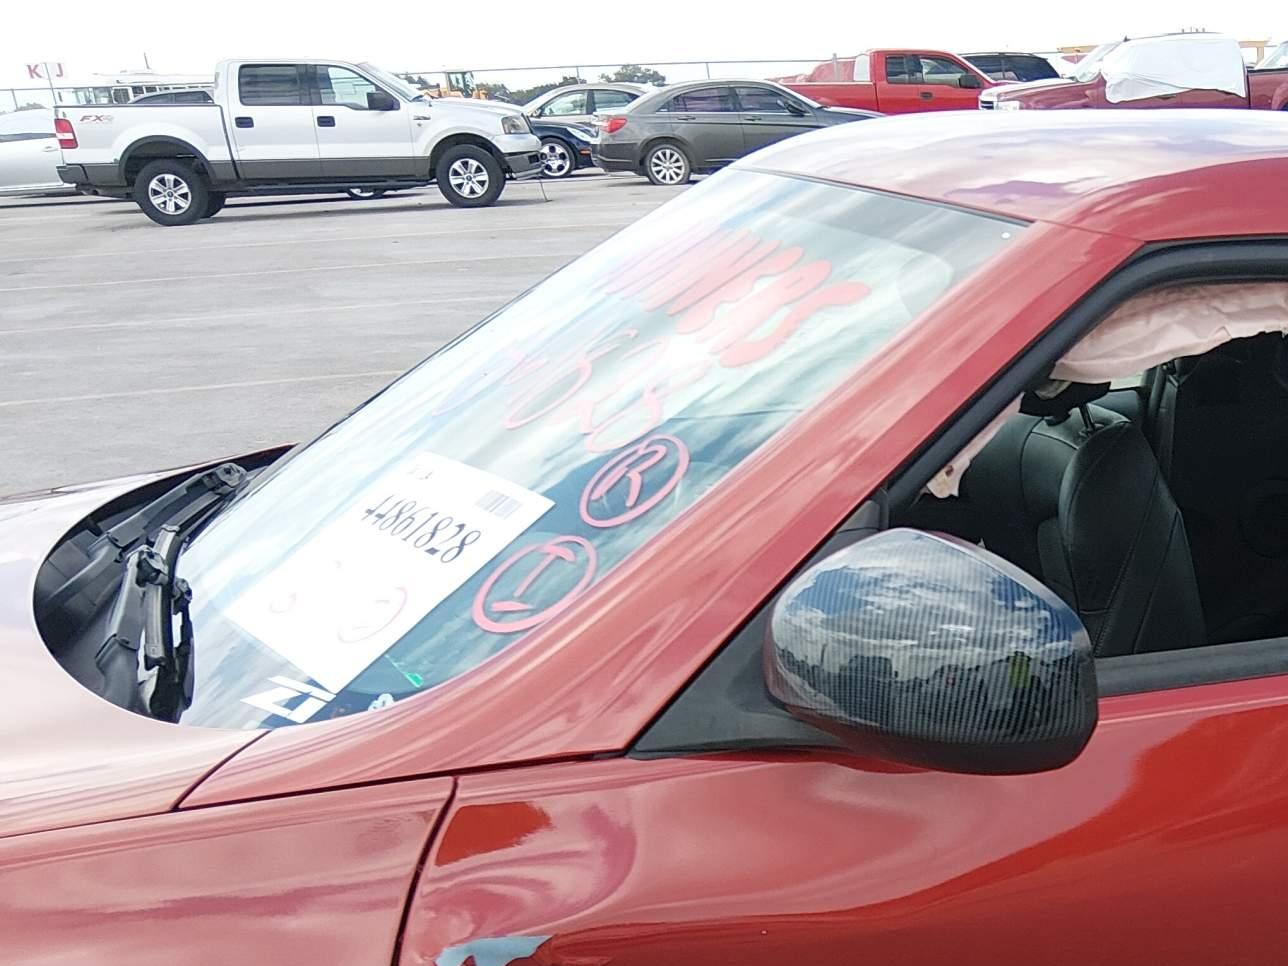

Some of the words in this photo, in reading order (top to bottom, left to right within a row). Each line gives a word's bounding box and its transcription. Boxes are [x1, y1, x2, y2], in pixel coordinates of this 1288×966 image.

[27, 64, 43, 78] K
[56, 63, 64, 77] J
[361, 493, 482, 564] 44861828
